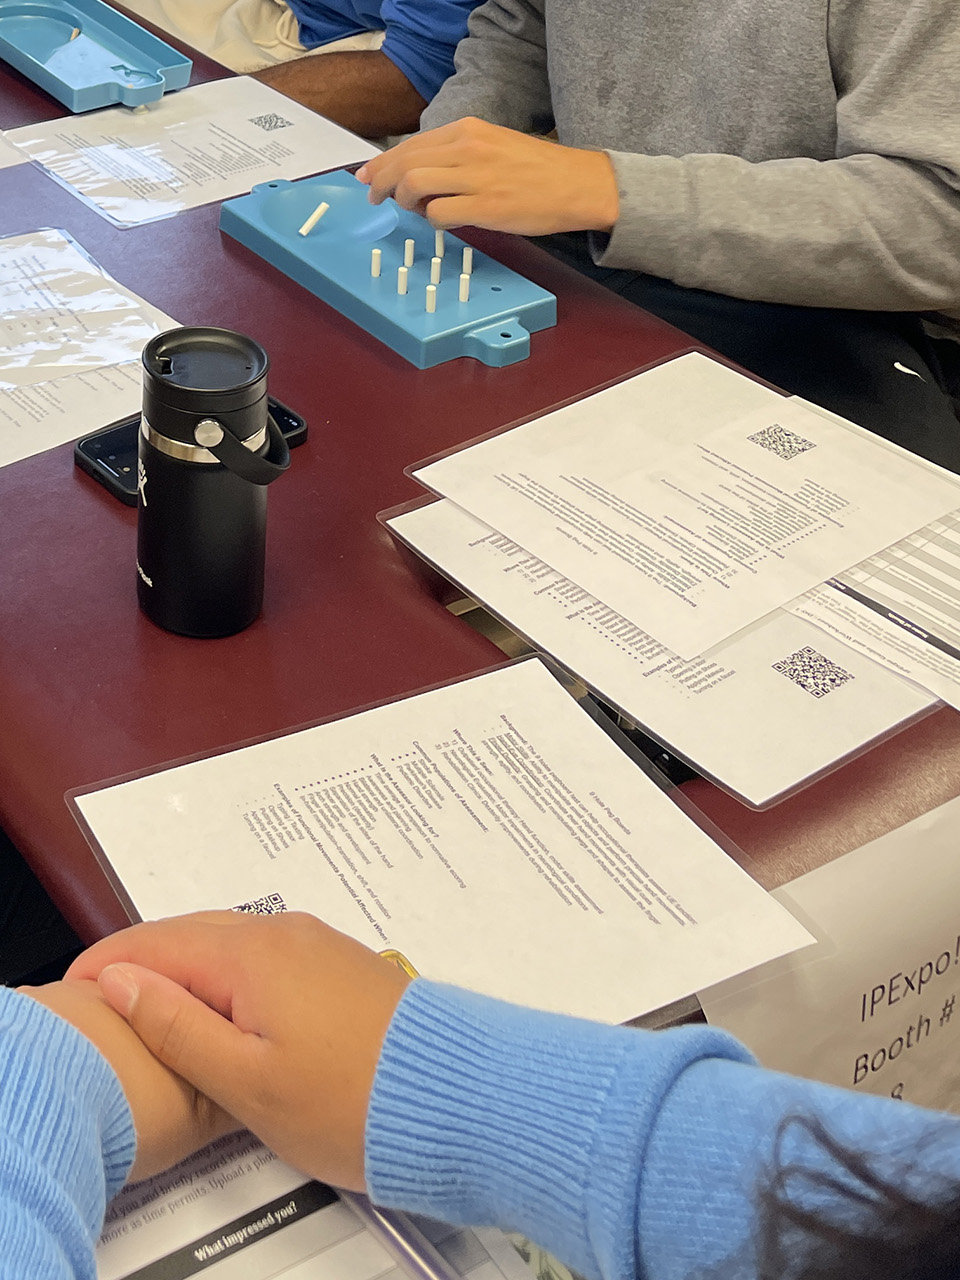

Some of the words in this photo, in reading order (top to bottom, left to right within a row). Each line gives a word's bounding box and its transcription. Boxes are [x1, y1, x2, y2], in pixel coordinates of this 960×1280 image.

[411, 740, 433, 763] Common
[427, 762, 457, 793] Populations
[458, 798, 490, 832] Assessment:
[451, 728, 468, 744] Where
[464, 744, 477, 756] This
[479, 761, 495, 776] Seen:
[369, 753, 383, 767] What
[390, 780, 413, 805] Assessor
[407, 804, 430, 827] Looking
[426, 826, 439, 838] for?
[592, 795, 606, 807] Hole
[601, 807, 615, 818] Peg
[612, 817, 631, 834] Boards
[271, 783, 295, 808] Examples
[294, 814, 319, 842] Functional
[314, 842, 340, 872] Movements
[336, 873, 359, 898] Potential
[355, 898, 377, 922] Affected
[372, 922, 389, 940] When
[860, 935, 960, 1022] IPExpo!
[853, 1015, 930, 1085] Booth
[938, 994, 956, 1027] #
[100, 1225, 129, 1245] more
[130, 1218, 143, 1231] as
[142, 1206, 167, 1225] time
[168, 1188, 210, 1214] permits.
[208, 1166, 244, 1191] Upload
[245, 1163, 253, 1173] a
[119, 1200, 139, 1217] you
[141, 1187, 160, 1205] and
[160, 1172, 193, 1195] briefly
[194, 1155, 227, 1178] record
[228, 1151, 236, 1162] it
[237, 1146, 250, 1157] on
[194, 1240, 225, 1262] What
[224, 1212, 275, 1245] impressed
[274, 1200, 298, 1222] you?
